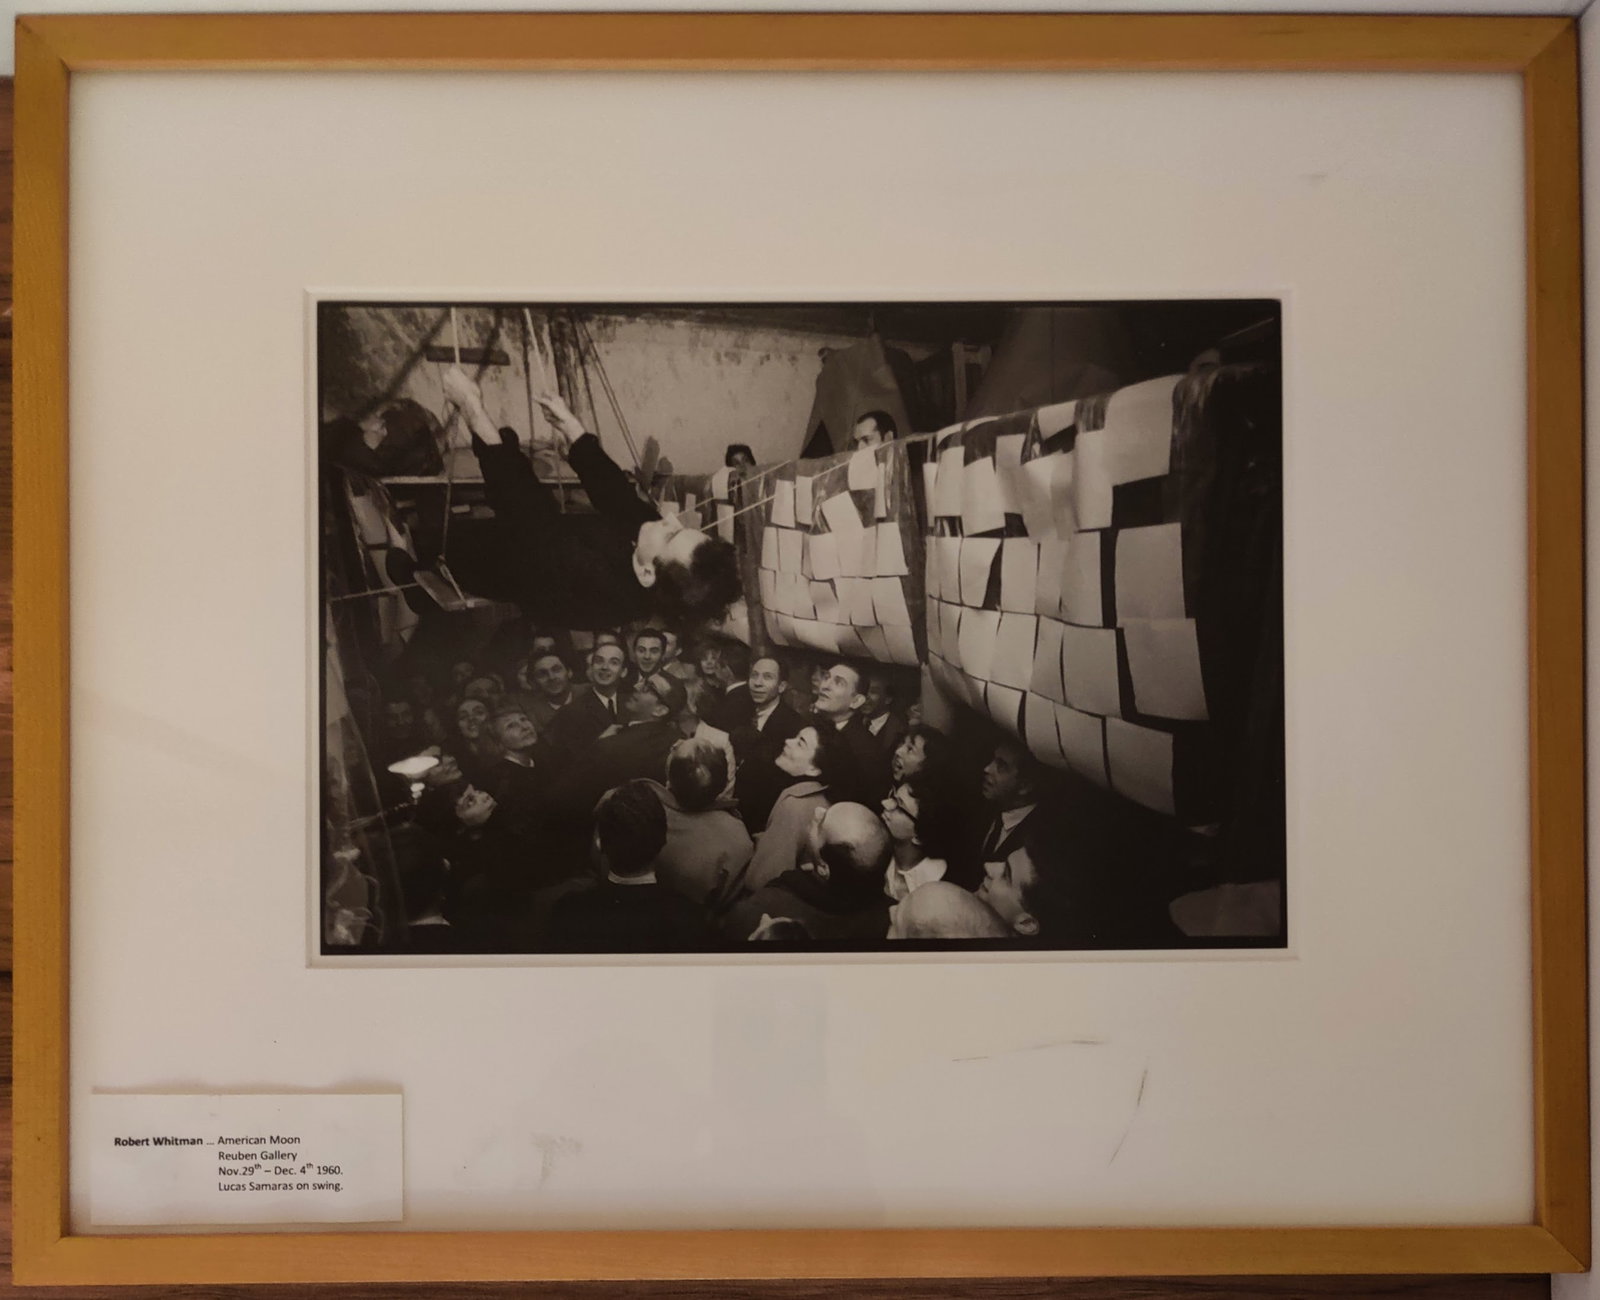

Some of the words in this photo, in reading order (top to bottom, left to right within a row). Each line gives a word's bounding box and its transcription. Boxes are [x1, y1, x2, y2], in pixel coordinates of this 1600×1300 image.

[114, 1137, 149, 1146] Robert
[153, 1137, 203, 1146] Whitman
[218, 1136, 266, 1145] American
[270, 1136, 300, 1144] Moon
[219, 1151, 257, 1160] Reuben
[260, 1150, 297, 1161] Gallery
[275, 1166, 296, 1175] Dec.
[317, 1166, 343, 1175] 1960.
[219, 1182, 246, 1191] Lucas
[249, 1182, 293, 1191] Samaras
[313, 1181, 343, 1192] swing.
